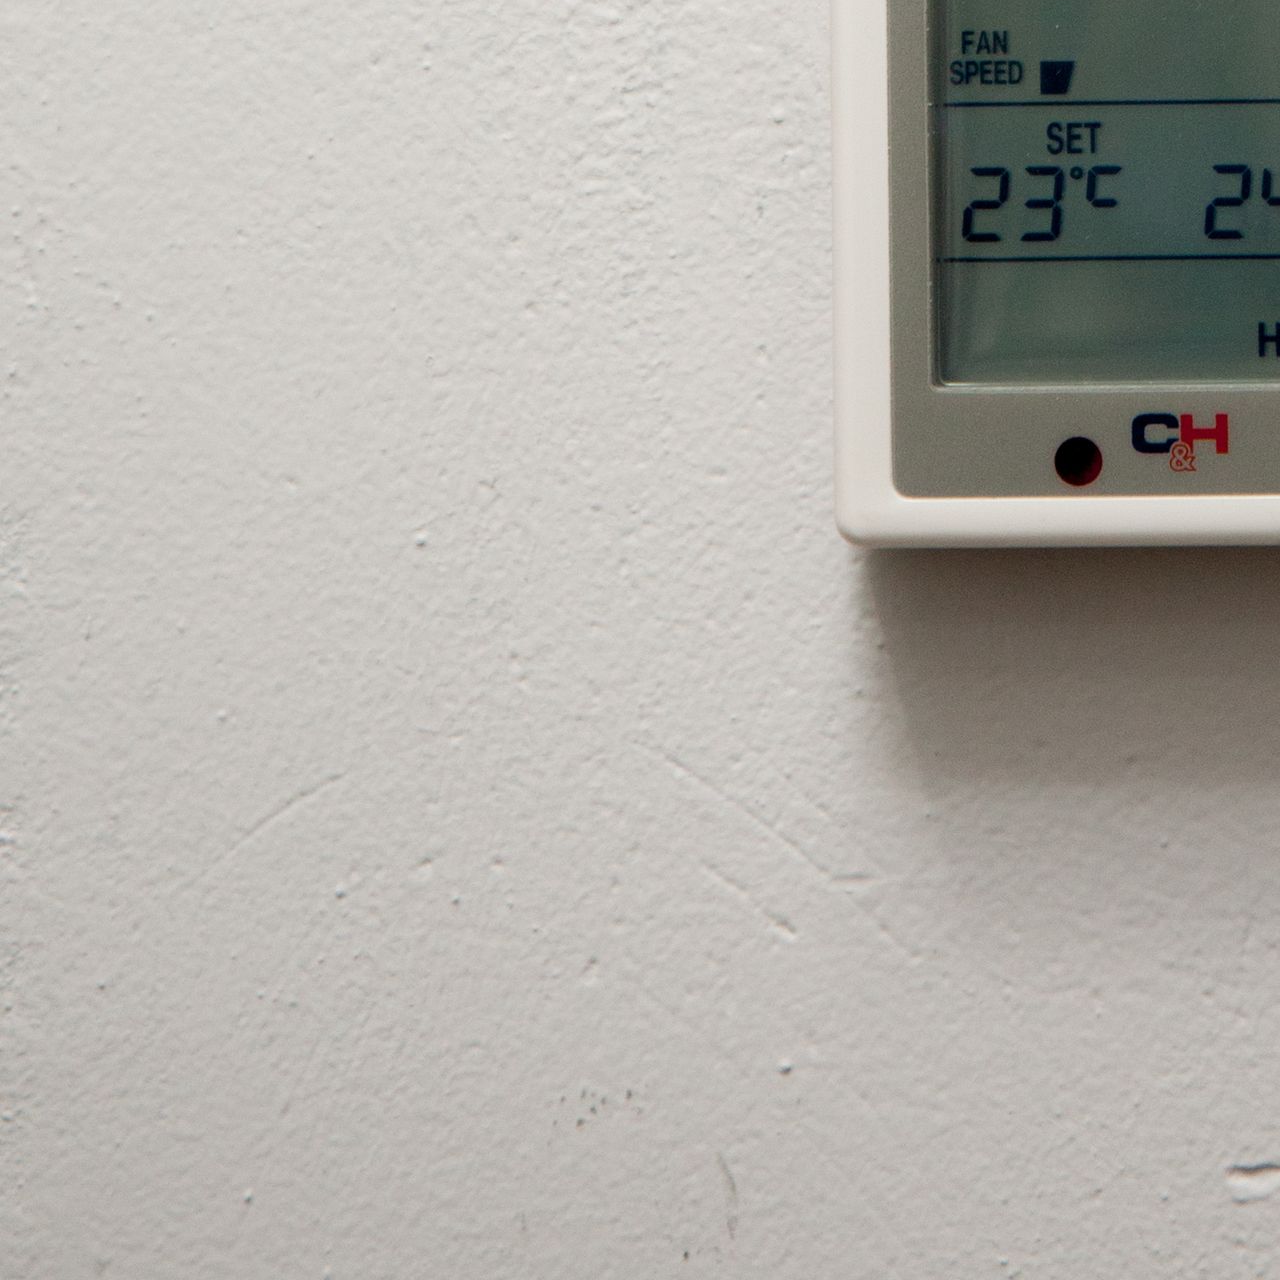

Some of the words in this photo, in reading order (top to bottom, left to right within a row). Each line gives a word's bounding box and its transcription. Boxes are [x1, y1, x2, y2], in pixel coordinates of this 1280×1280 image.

[960, 31, 1009, 55] FAN
[950, 60, 1023, 86] SPEED
[1045, 122, 1102, 154] SET
